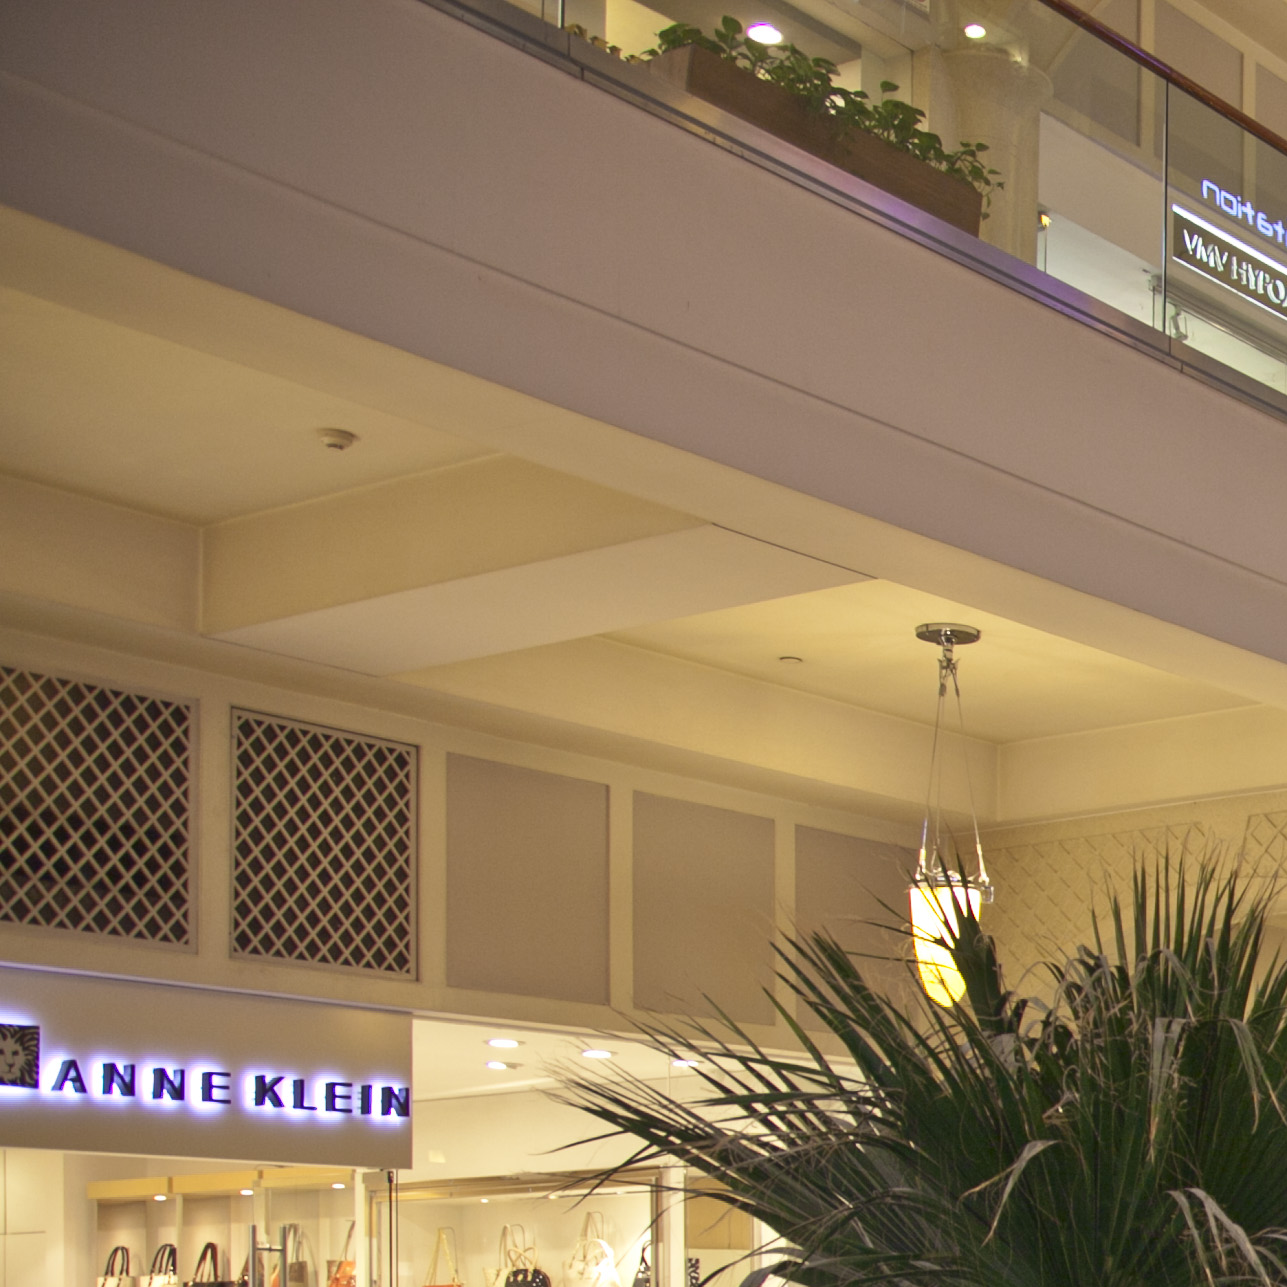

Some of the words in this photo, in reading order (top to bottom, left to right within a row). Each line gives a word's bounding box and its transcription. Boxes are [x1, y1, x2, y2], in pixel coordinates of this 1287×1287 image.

[1183, 228, 1228, 272] VMV
[51, 1059, 231, 1104] ANNE
[254, 1075, 410, 1117] KLEIN
